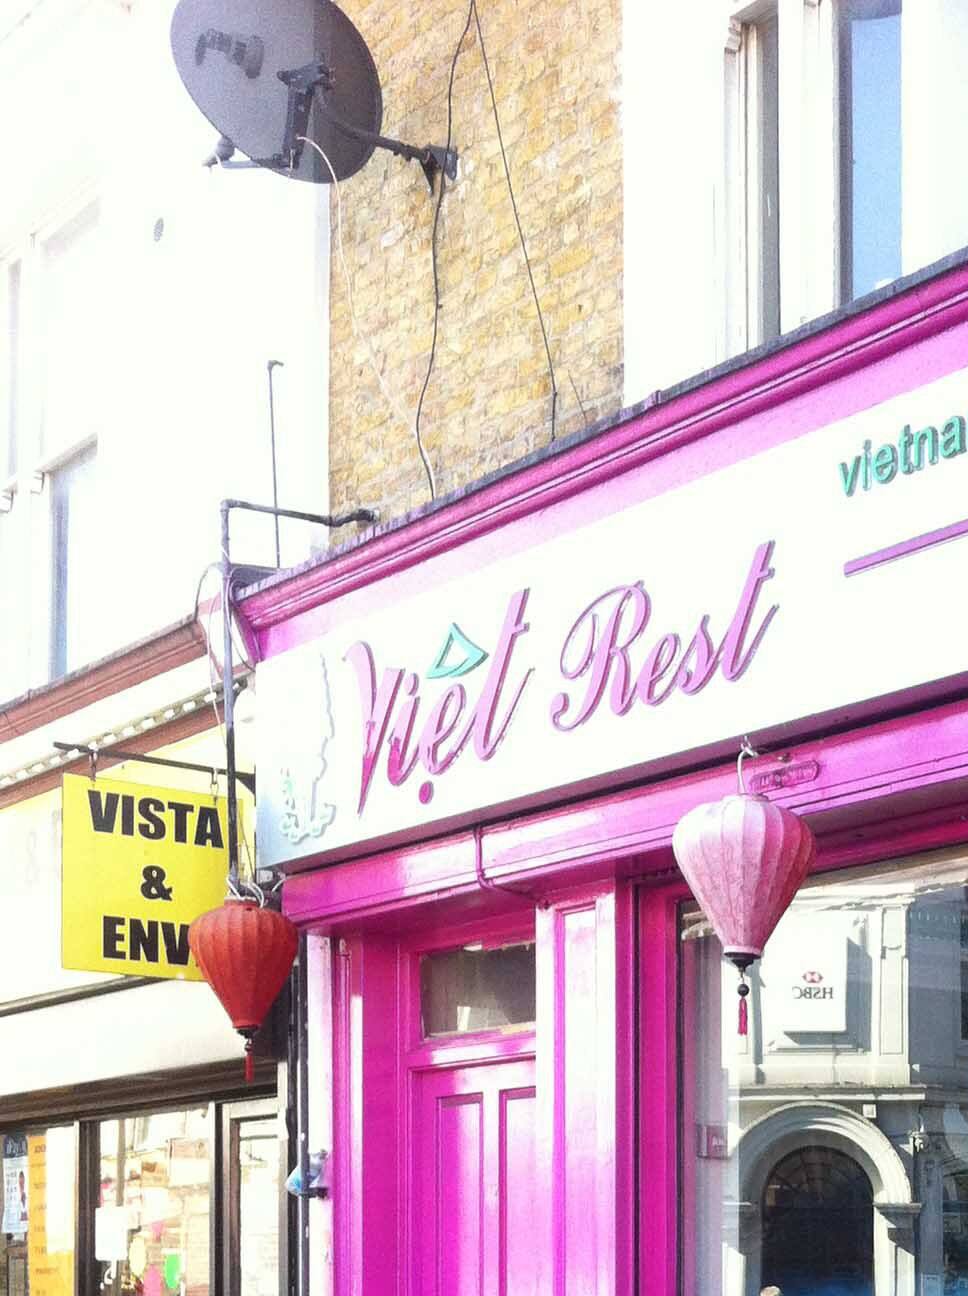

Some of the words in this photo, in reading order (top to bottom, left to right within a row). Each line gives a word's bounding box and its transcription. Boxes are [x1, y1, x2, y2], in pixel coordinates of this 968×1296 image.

[550, 540, 780, 732] Rest
[87, 789, 225, 849] VISTA
[139, 864, 173, 901] &
[102, 915, 199, 968] ENV
